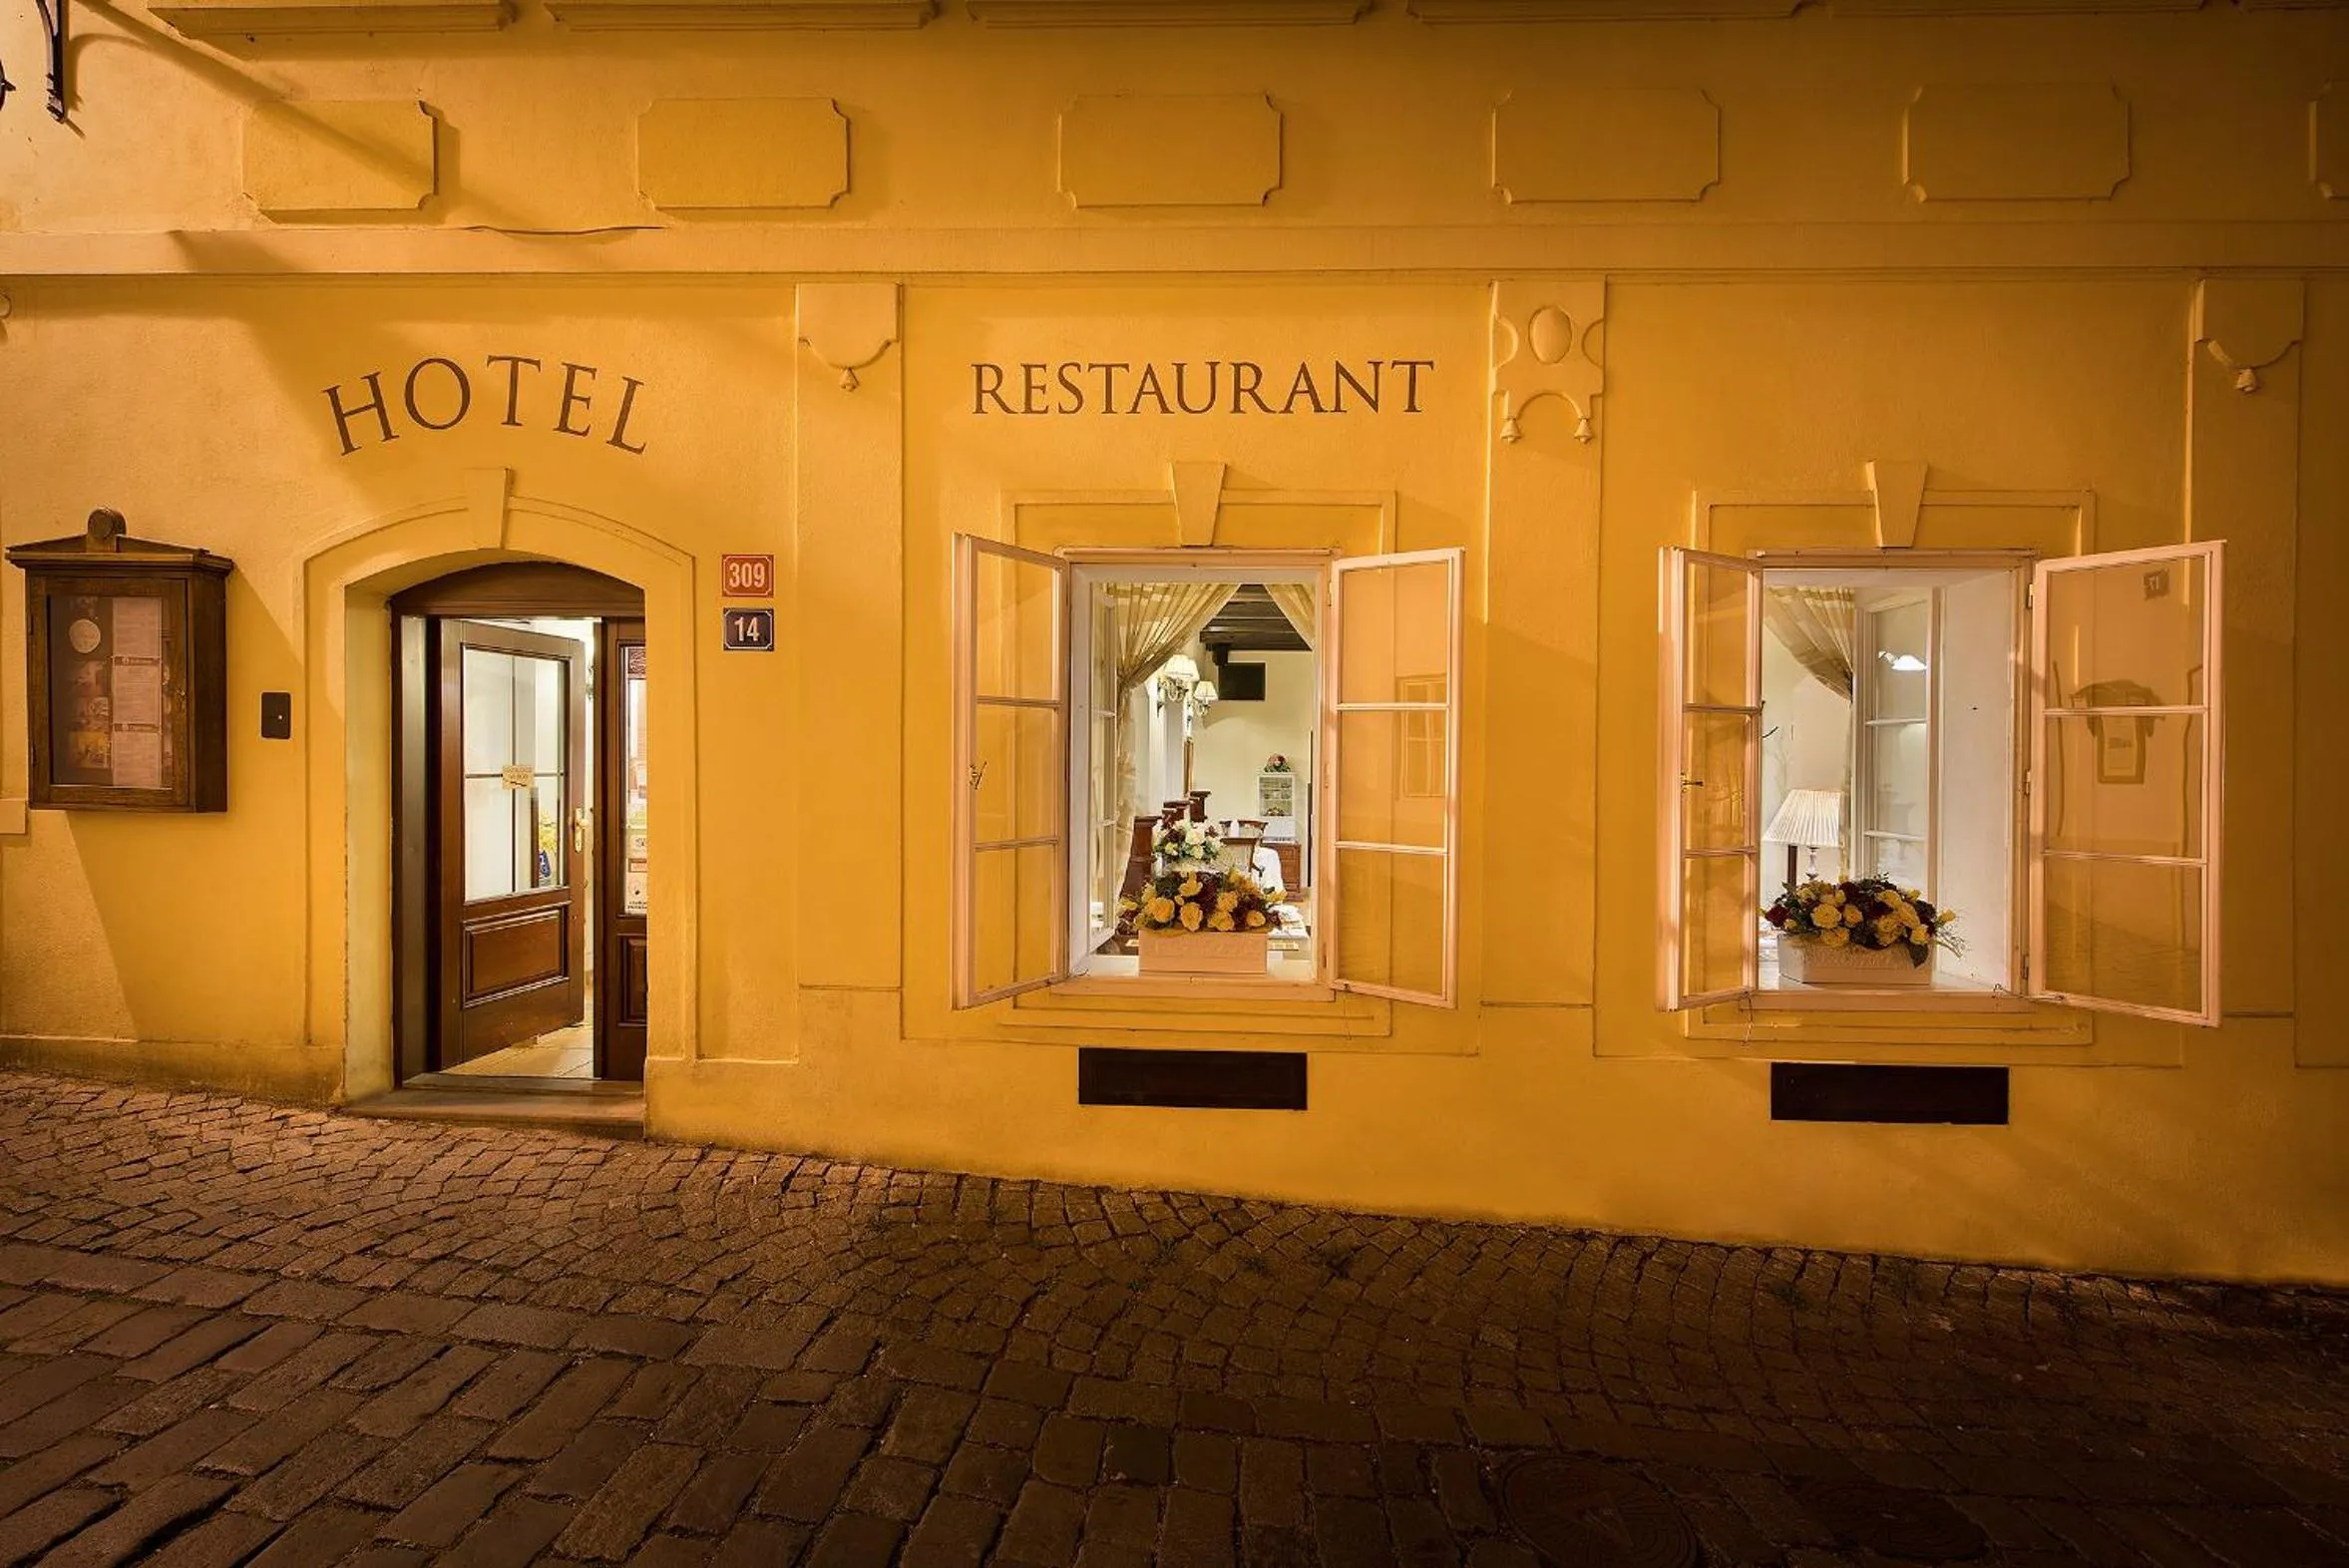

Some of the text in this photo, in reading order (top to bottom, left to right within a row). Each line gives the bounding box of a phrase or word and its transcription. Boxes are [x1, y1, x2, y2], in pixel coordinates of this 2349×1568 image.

[322, 355, 646, 456] HOTEL
[971, 360, 1434, 415] RESTAURANT
[729, 563, 765, 588] 309
[734, 616, 760, 641] 14
